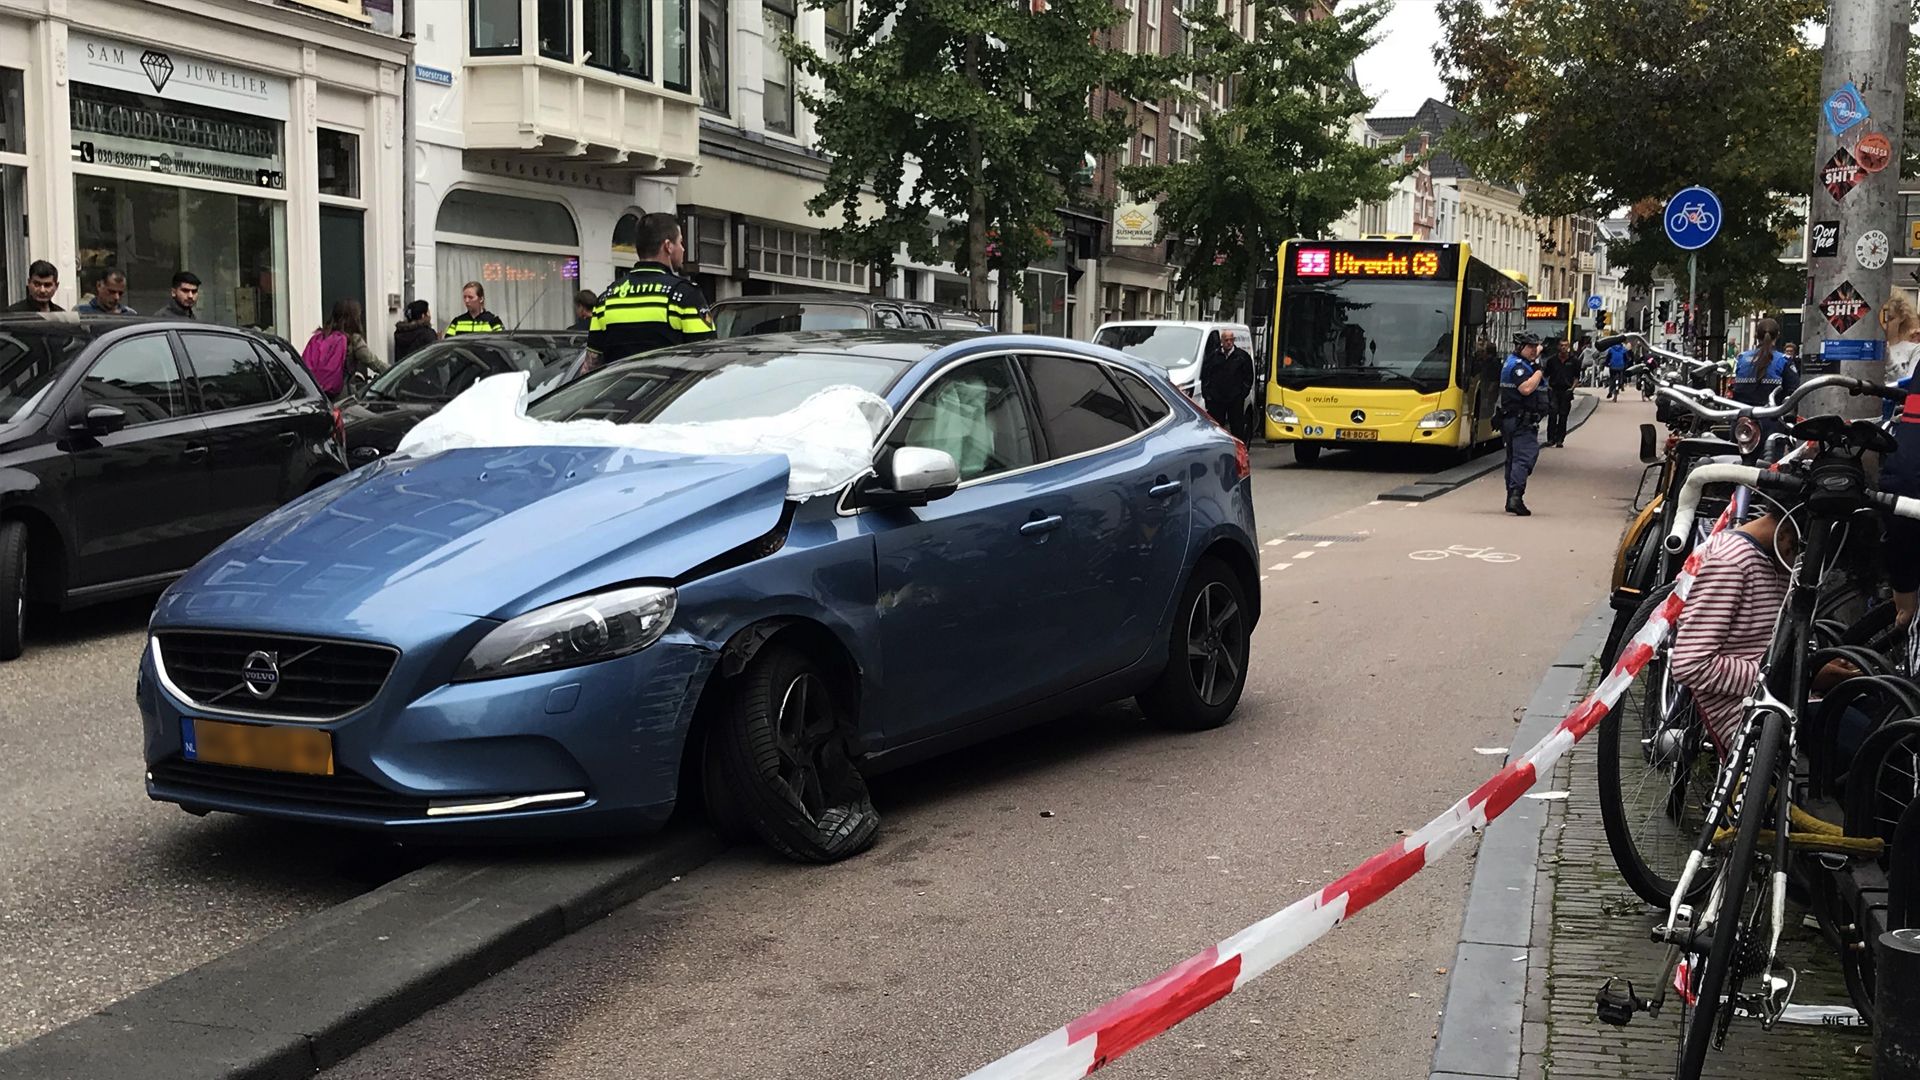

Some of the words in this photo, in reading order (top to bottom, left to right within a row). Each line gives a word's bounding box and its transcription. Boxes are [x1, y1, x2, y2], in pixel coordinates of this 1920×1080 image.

[87, 43, 125, 65] SAM
[185, 64, 268, 94] JUWELIER
[417, 67, 450, 83] Voorstraat
[97, 151, 113, 165] 030
[115, 151, 149, 168] 6368777
[1825, 170, 1858, 185] SHIT
[1813, 224, 1838, 238] Don
[1335, 252, 1408, 275] Utrecht
[1412, 252, 1438, 275] CS
[1826, 303, 1861, 317] SHIT
[244, 671, 276, 682] VOLVO
[185, 742, 196, 753] NL
[1821, 1014, 1854, 1026] NIET
